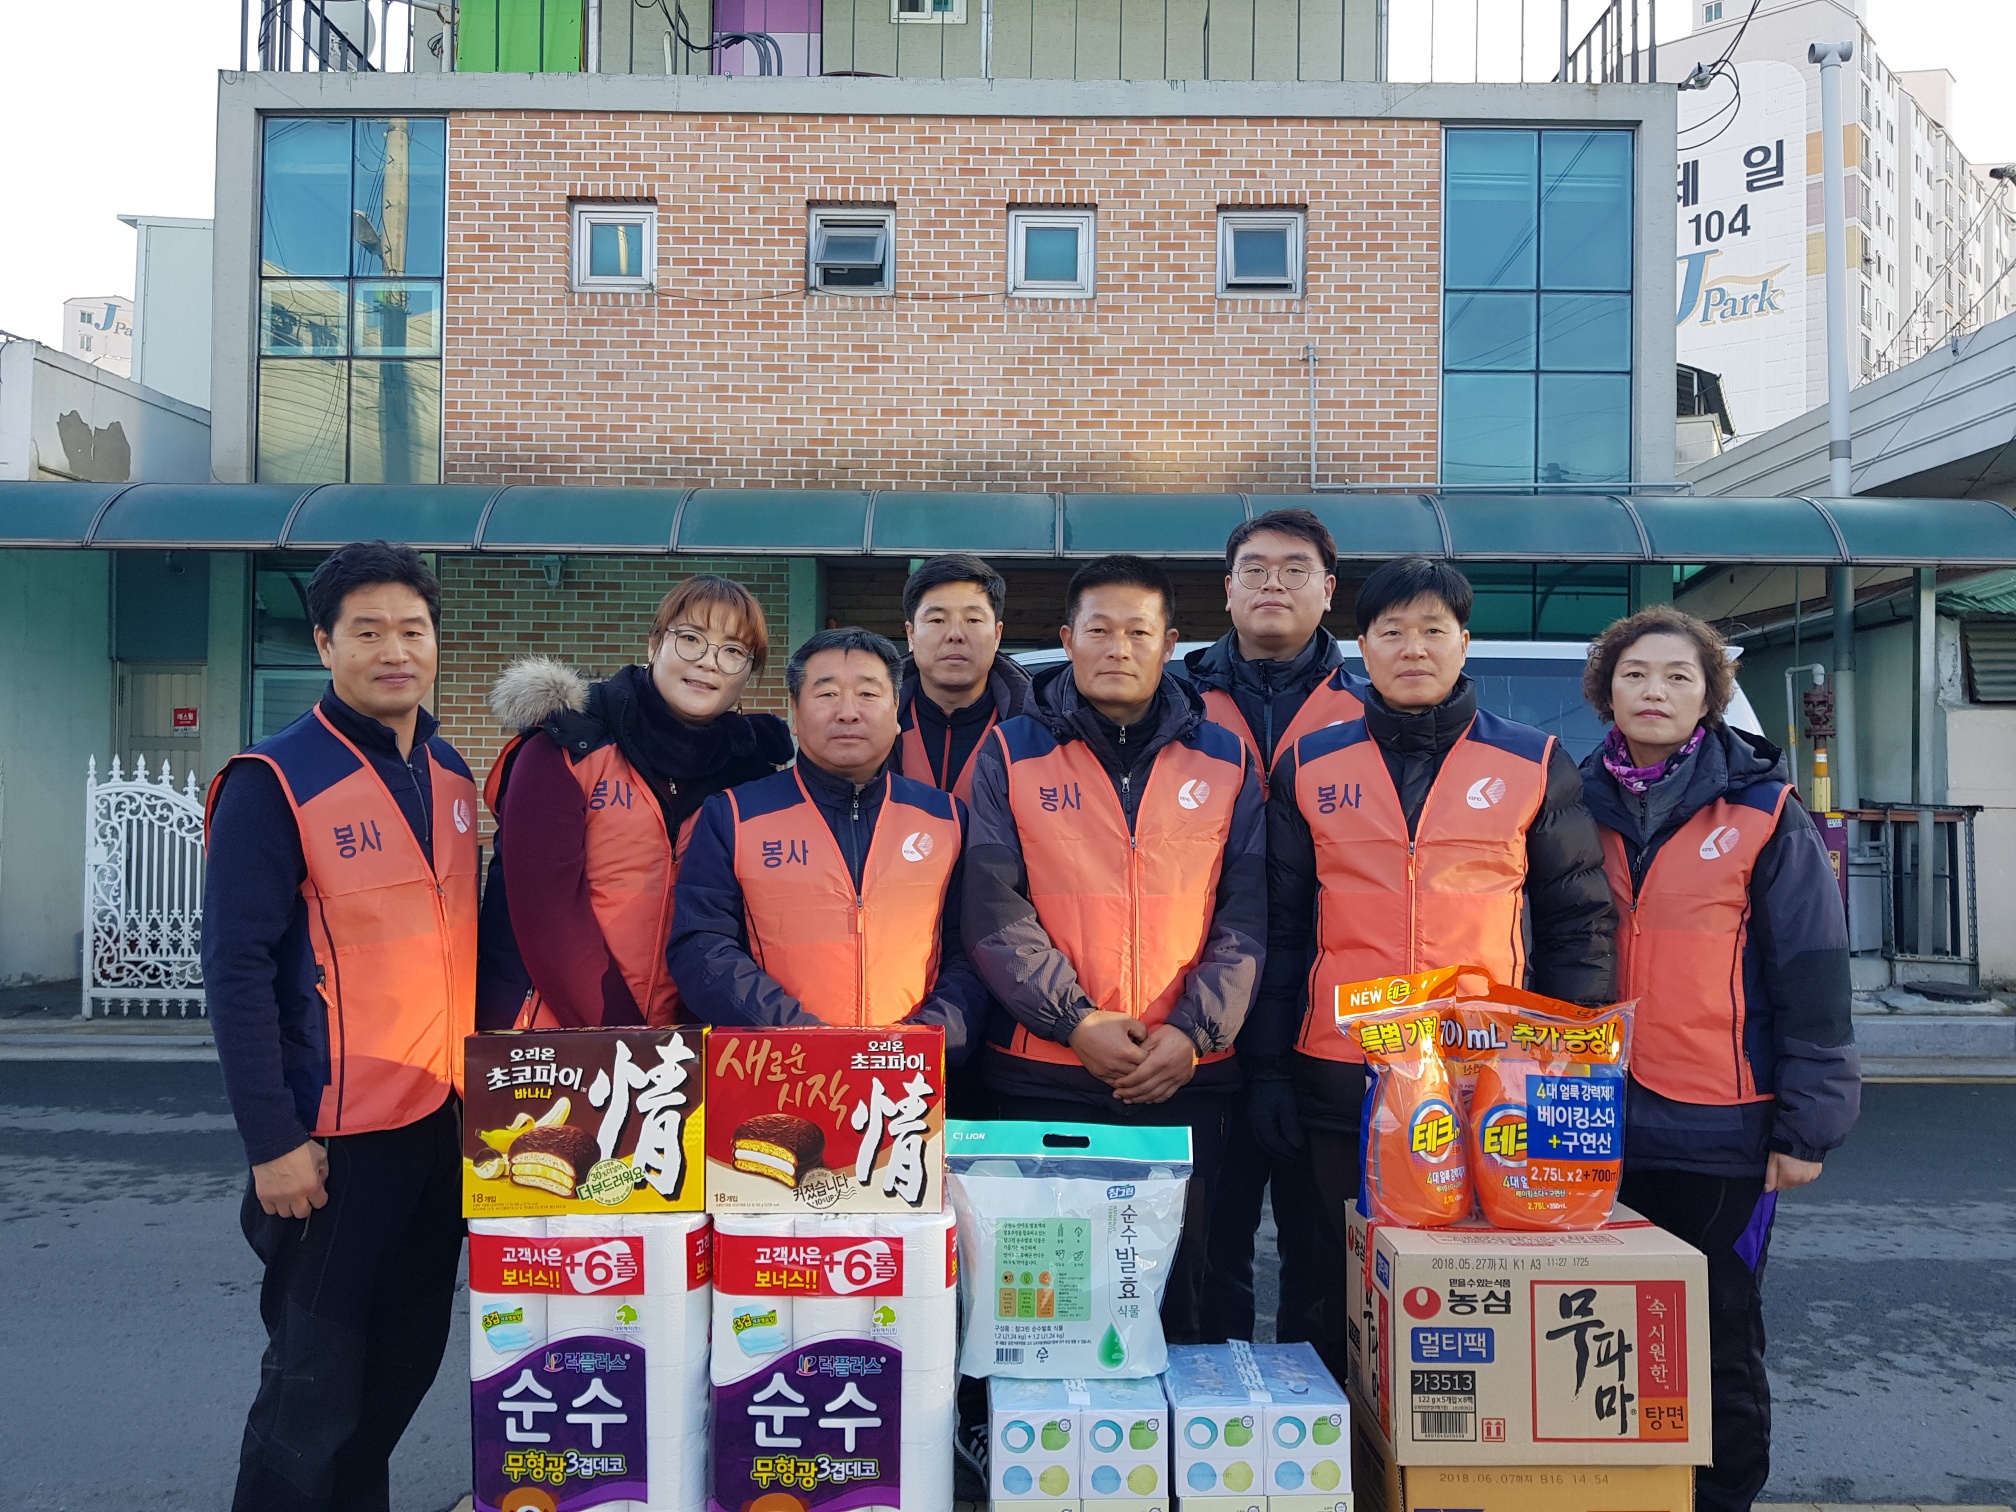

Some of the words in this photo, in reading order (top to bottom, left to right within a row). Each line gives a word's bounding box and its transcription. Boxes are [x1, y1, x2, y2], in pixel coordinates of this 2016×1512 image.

[1688, 204, 1751, 246] 104
[1701, 278, 1784, 326] Park
[114, 321, 132, 337] Pa
[590, 780, 633, 810] 봉사
[1040, 783, 1081, 812] 봉사
[1318, 784, 1362, 814] 봉사
[334, 820, 382, 859] 봉사
[762, 840, 808, 868] 봉사
[1350, 987, 1382, 1007] NEW
[1386, 983, 1411, 1001] 테크
[867, 1040, 904, 1052] 오리온
[1360, 1022, 1406, 1055] 특별
[1467, 1022, 1507, 1049] mL
[1511, 1022, 1560, 1052] 추가
[1563, 1023, 1617, 1054] 증정!
[510, 1047, 556, 1062] 오리온
[715, 1037, 807, 1086] 새로운
[850, 1053, 925, 1071] 초코파이
[486, 1063, 584, 1092] 초코파이
[514, 1087, 553, 1100] 바나나
[777, 1070, 850, 1130] 시작
[1536, 1083, 1557, 1100] 4대
[1560, 1084, 1580, 1101] 얼룩
[588, 1032, 696, 1194] 情
[1537, 1105, 1615, 1129] 베이킹소다
[851, 1072, 934, 1202] 情
[953, 1132, 964, 1141] CJ
[965, 1132, 986, 1140] LION
[1412, 1114, 1455, 1152] 테크
[1531, 1166, 1565, 1182] 2.75L
[471, 1193, 497, 1203] 18개입
[714, 1193, 738, 1203] 18개입
[793, 1173, 848, 1202] 커졌습니다
[501, 1247, 562, 1267] 고객사은
[755, 1246, 822, 1265] 고객사은
[1115, 1204, 1140, 1299] 순수발효
[1432, 1258, 1508, 1271] 2018.05.27까지
[1513, 1258, 1525, 1270] K1
[1530, 1258, 1542, 1270] A3
[1547, 1257, 1567, 1267] 11:27
[1573, 1257, 1589, 1267] 1725
[502, 1268, 561, 1288] 보너스!!
[754, 1269, 817, 1289] 보너스!!
[1117, 1304, 1140, 1318] 식물
[1448, 1289, 1511, 1315] 농심
[482, 1311, 501, 1327] 3겹
[733, 1313, 752, 1330] 3겹
[1418, 1331, 1487, 1358] 멀티팩
[564, 1352, 627, 1374] 럭플러스
[818, 1355, 882, 1377] 럭플러스
[1546, 1288, 1634, 1435] 무파마
[1414, 1372, 1473, 1392] 가3513
[498, 1368, 628, 1449] 순수
[747, 1372, 882, 1453] 순수
[1645, 1405, 1684, 1430] 탕면
[1439, 1473, 1532, 1485] 2018.06.07까지
[1540, 1474, 1563, 1484] B16
